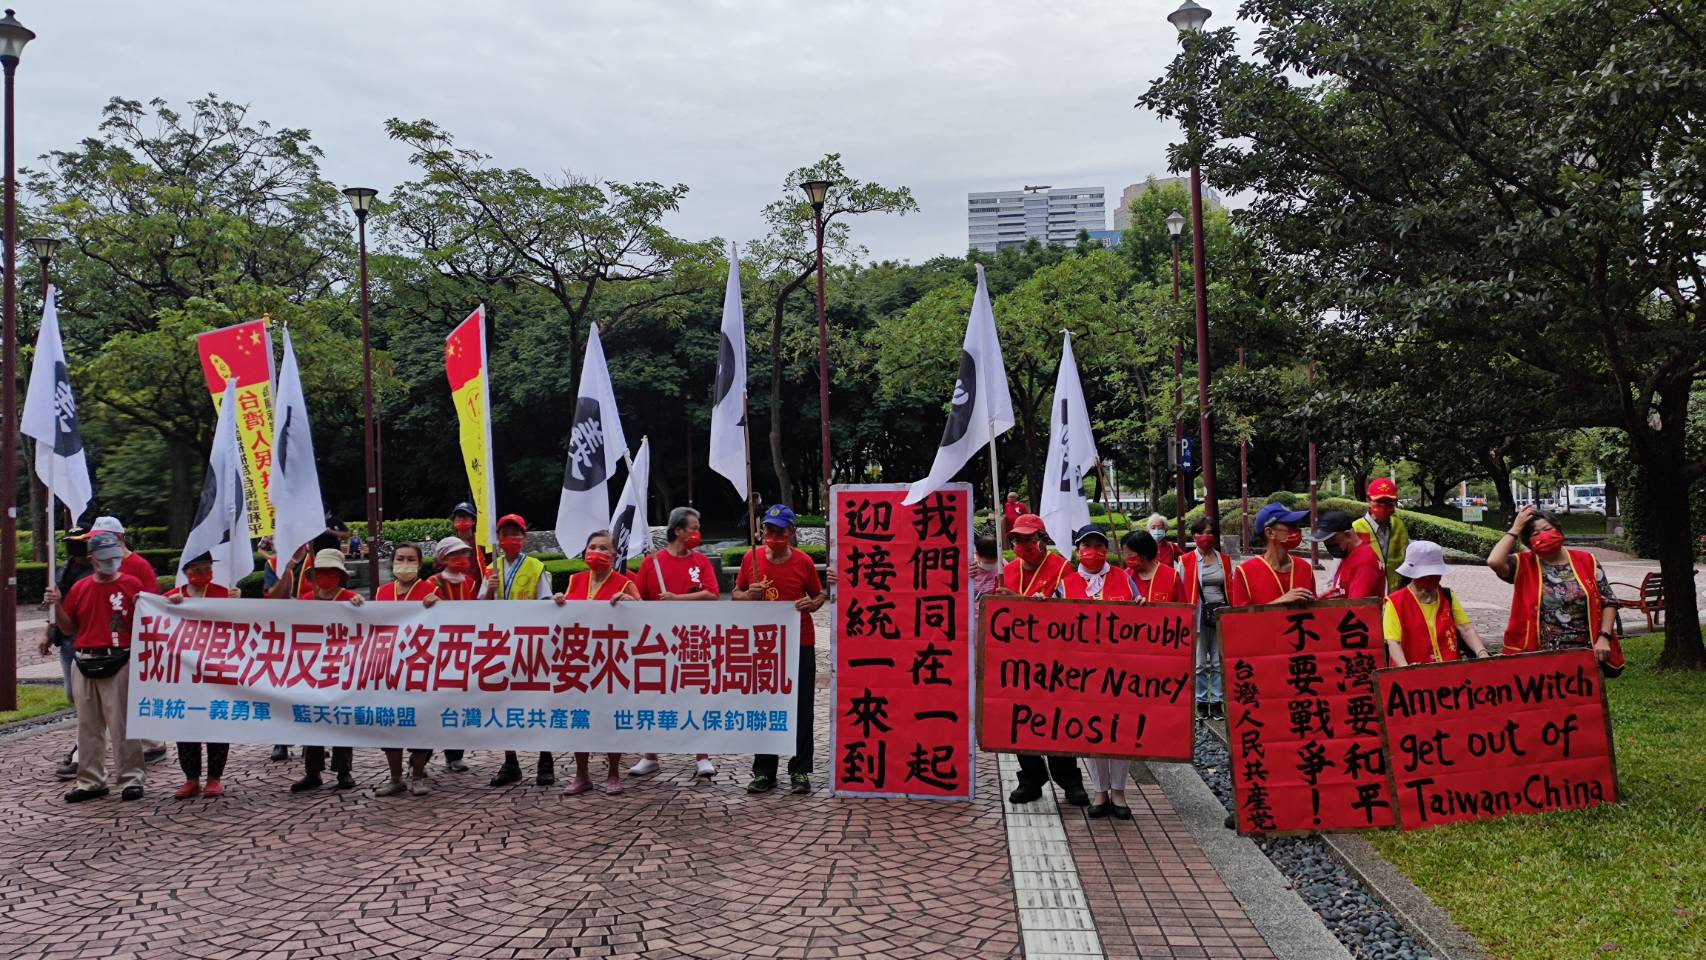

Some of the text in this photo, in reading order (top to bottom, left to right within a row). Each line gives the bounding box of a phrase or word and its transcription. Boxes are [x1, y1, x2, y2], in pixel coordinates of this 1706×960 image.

[1181, 438, 1189, 457] P
[840, 498, 902, 789] 迎接統一來到
[904, 494, 961, 791] 我們同在一起
[990, 607, 1040, 643] Get
[138, 616, 793, 693] 我們堅決反對佩洛西老巫婆來台灣搗亂
[1100, 666, 1190, 704] Nancy
[1386, 665, 1593, 718] American Witch
[137, 696, 789, 732] 台灣統一義勇軍 藍天行動聯盟 台灣人民共產黨 世界華人保釣聯盟
[1335, 610, 1389, 824] 台灣要和平
[1399, 713, 1579, 773] get out of
